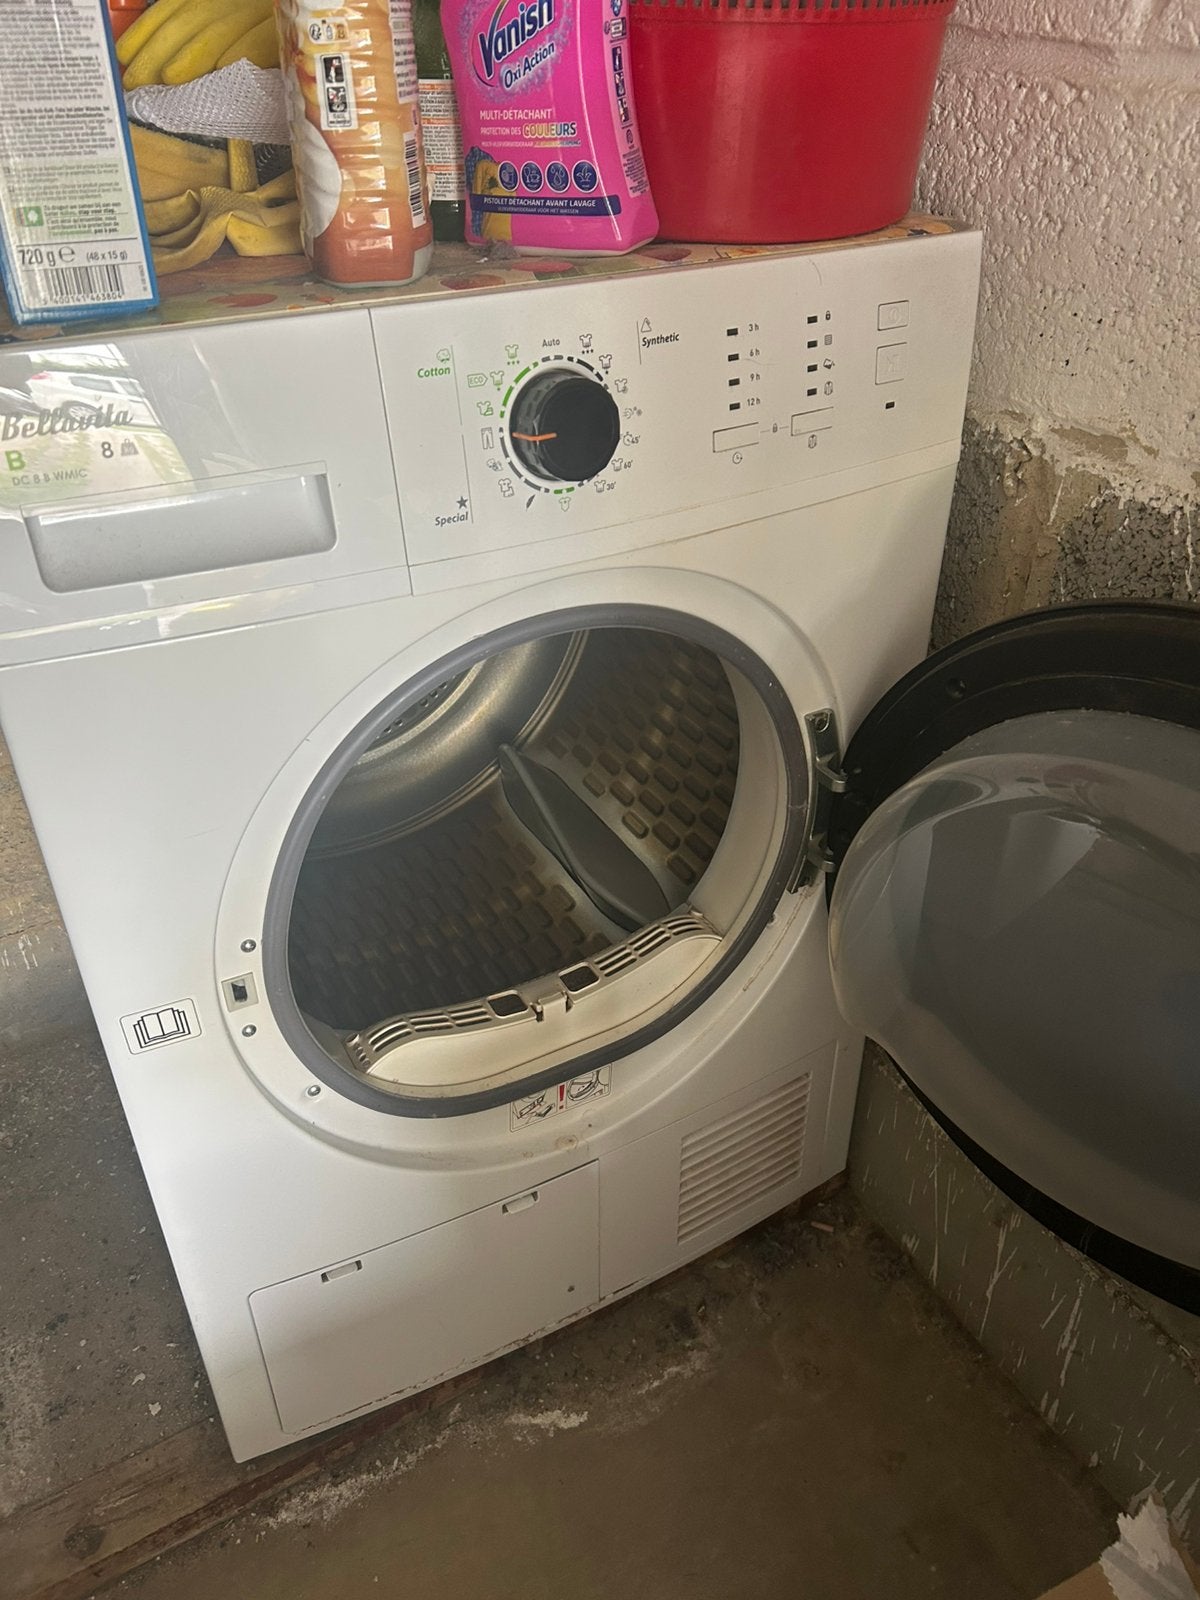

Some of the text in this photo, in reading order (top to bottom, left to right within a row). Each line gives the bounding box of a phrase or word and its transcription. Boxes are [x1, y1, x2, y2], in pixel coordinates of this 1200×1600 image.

[479, 0, 553, 78] Vanish
[504, 43, 554, 88] Oxi Action
[480, 107, 552, 120] MULTI-DÉTACHANT
[480, 122, 577, 138] PROTECTION DES COULEURS
[484, 197, 508, 205] PISTOLET
[508, 198, 544, 206] DÉTACHANT
[17, 248, 44, 265] 720
[47, 252, 56, 267] g
[86, 252, 100, 263] (48
[108, 250, 118, 259] 15
[120, 250, 128, 260] g)
[90, 292, 122, 302] 463804
[541, 338, 561, 348] Auto
[641, 332, 681, 348] Synthetic
[417, 366, 451, 379] Cotton
[469, 376, 484, 385] ECO
[1, 403, 133, 441] Bellavita
[5, 441, 114, 471] B 8
[12, 475, 30, 486] DC
[434, 512, 470, 528] Special
